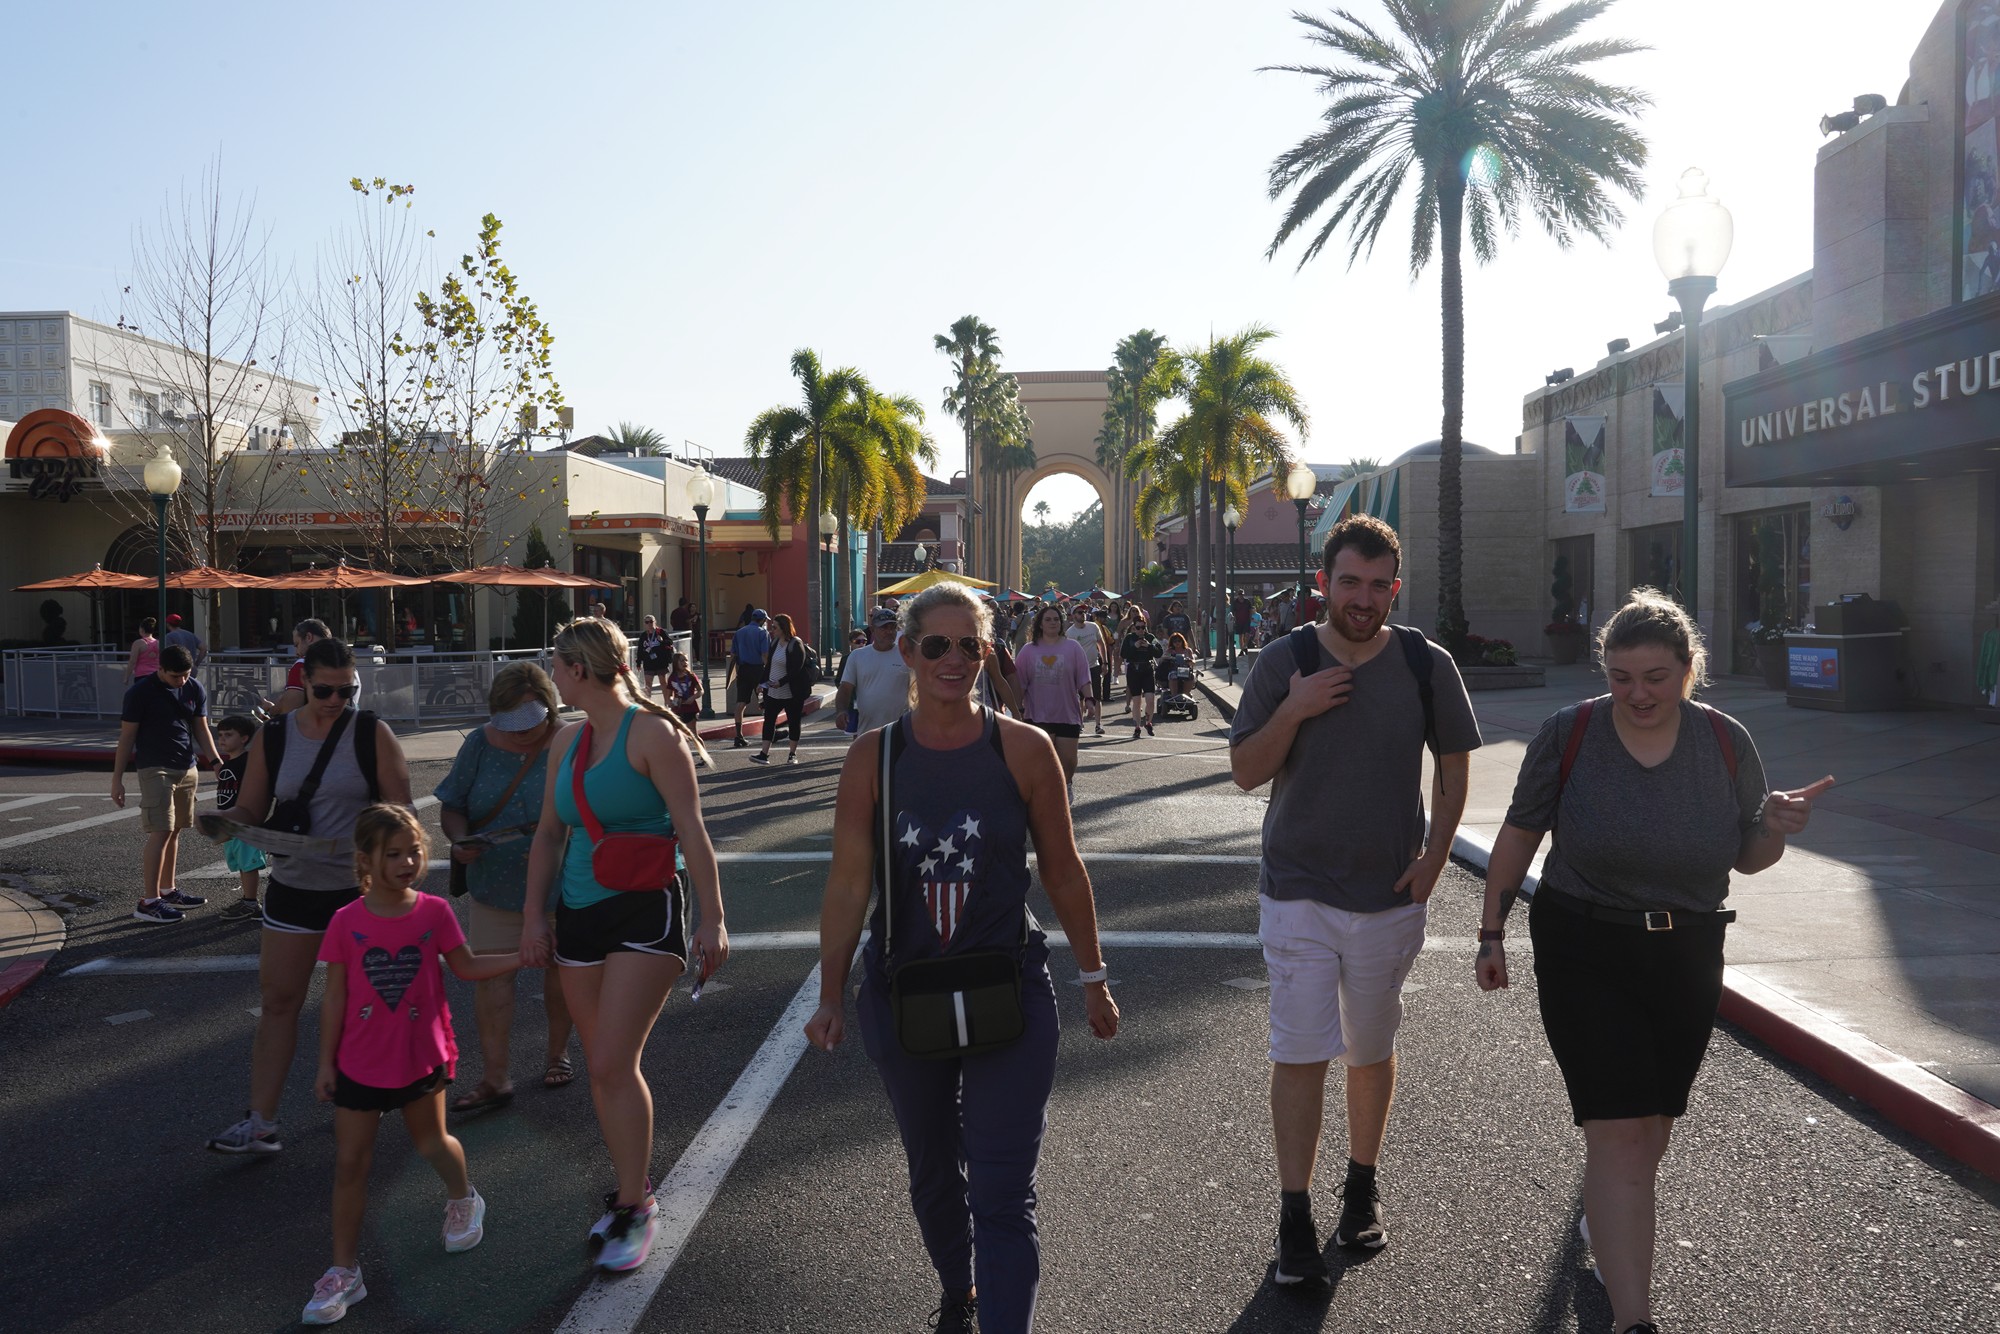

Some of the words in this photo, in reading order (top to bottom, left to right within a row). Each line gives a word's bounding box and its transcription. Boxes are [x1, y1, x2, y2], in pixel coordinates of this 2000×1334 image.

[1741, 381, 1897, 448] UNIVERSAL
[217, 513, 314, 526] SANDWICHES
[362, 512, 403, 524] SOP
